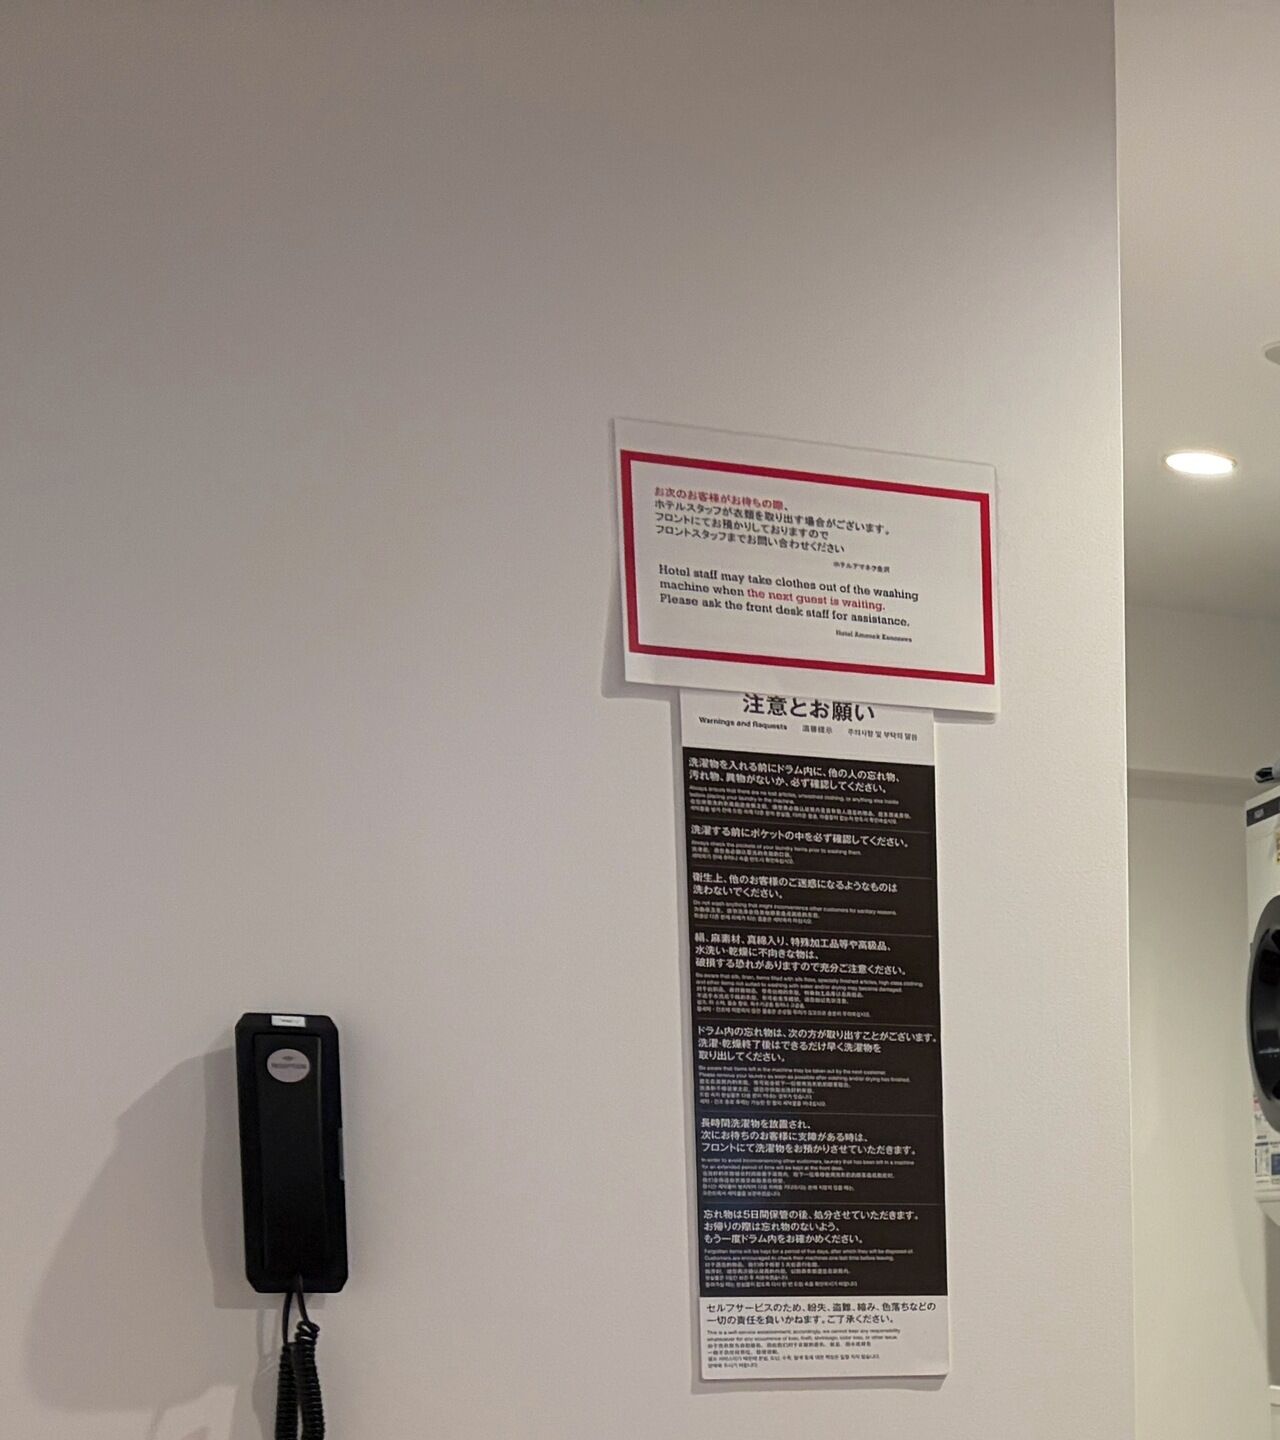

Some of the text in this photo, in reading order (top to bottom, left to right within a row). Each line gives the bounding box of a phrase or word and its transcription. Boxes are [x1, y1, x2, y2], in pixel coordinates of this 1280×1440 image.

[659, 564, 919, 603] Hotel staff may take clothes out of the washing
[660, 580, 885, 612] machine when the next guest is waiting.
[660, 593, 910, 627] Please ask the front desk staff for assistance.
[743, 693, 875, 722] 注意とお願い
[699, 716, 788, 731] Warnings and Requests
[693, 885, 783, 899] 洗わないでください。
[699, 1050, 785, 1063] 取り出してください。
